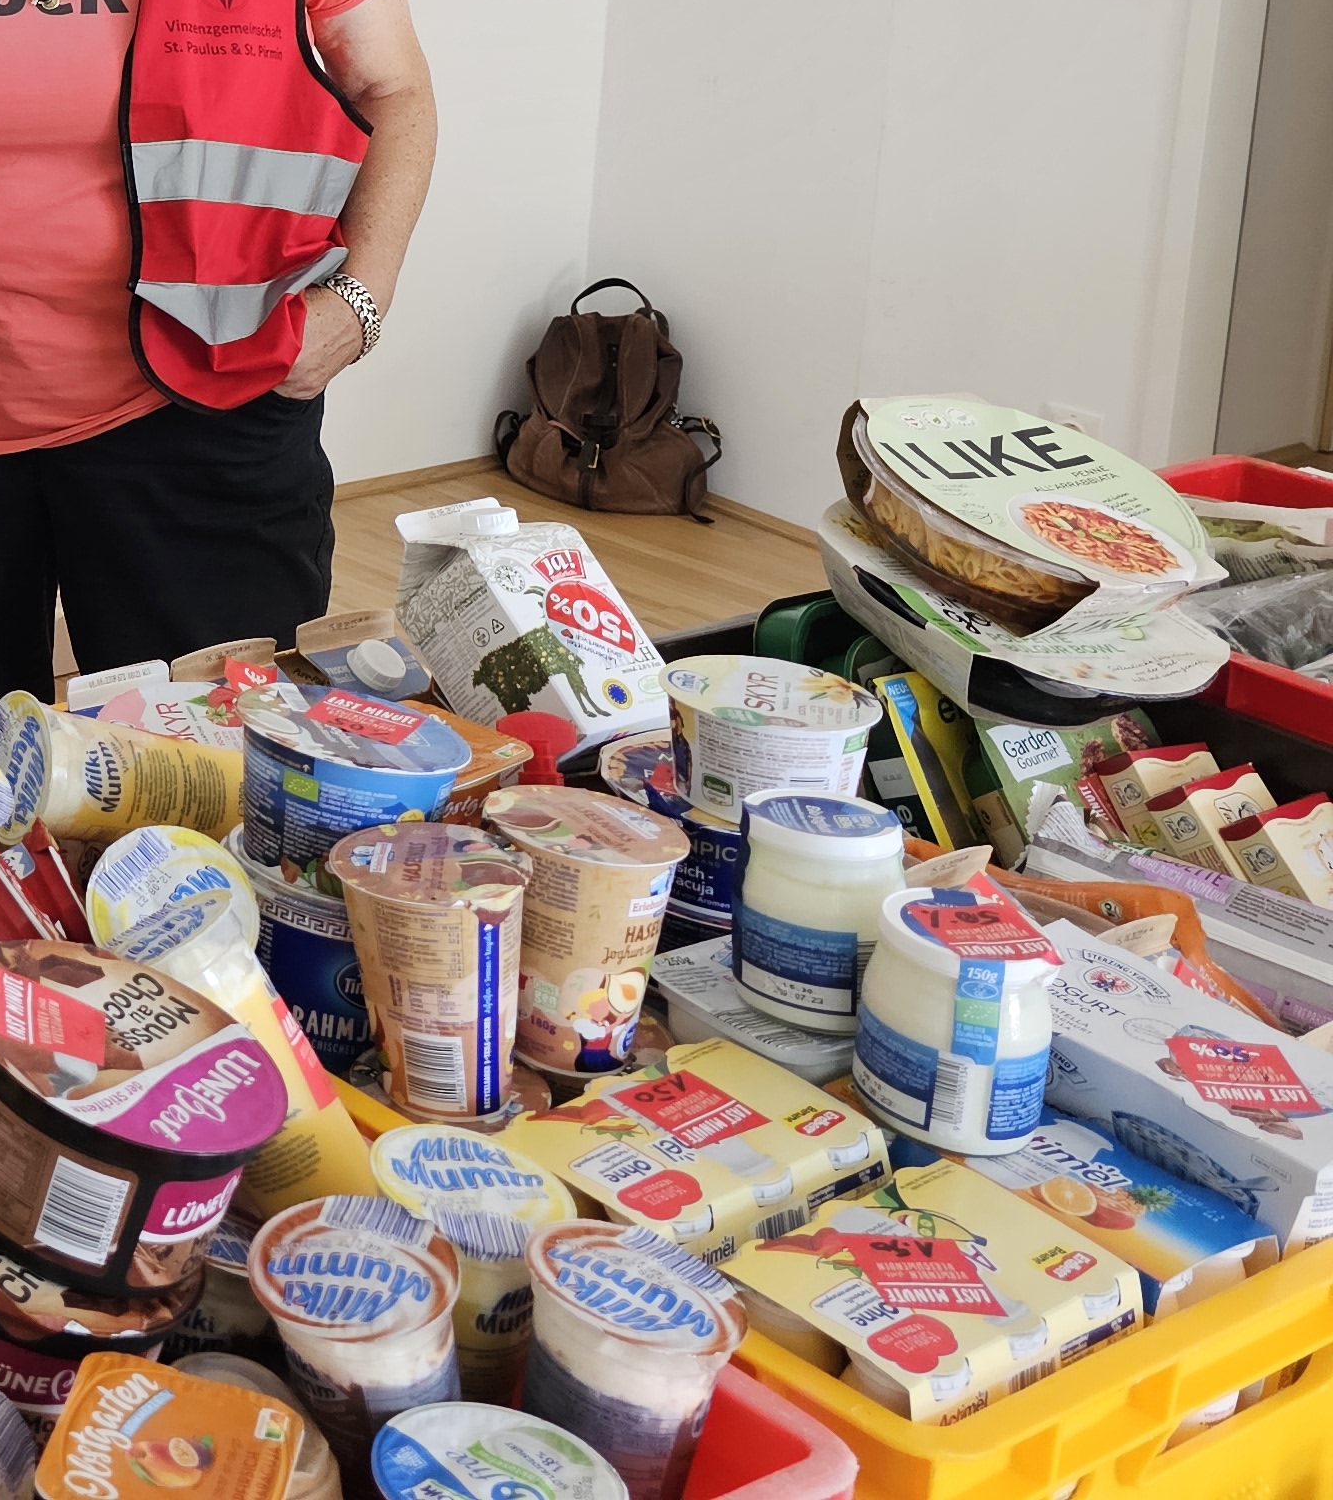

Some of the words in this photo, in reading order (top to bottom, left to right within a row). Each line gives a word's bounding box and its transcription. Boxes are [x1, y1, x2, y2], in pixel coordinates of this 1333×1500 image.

[165, 20, 282, 40] Vinzenzgemeinschaft
[164, 41, 183, 54] St.
[186, 41, 226, 56] Paulus
[231, 44, 242, 56] &
[245, 44, 256, 57] St.
[258, 45, 283, 61] Pirmin
[879, 442, 930, 479] I
[905, 425, 1094, 479] LIKE
[1034, 471, 1120, 493] ALL'ARRABBIATA
[1071, 465, 1109, 478] PENNE
[549, 590, 634, 650] -50%
[1071, 643, 1124, 654] BOWL
[744, 672, 779, 712] SKYR
[329, 696, 362, 711] LAST
[364, 706, 419, 726] MINUTE
[1002, 728, 1058, 760] Garden
[85, 738, 103, 800] Milki
[1017, 746, 1060, 770] Gourmet
[100, 741, 122, 814] Mumm
[673, 873, 714, 896] acuja
[677, 864, 705, 881] sich
[1130, 854, 1183, 883] KNOBLAUCH
[1185, 874, 1231, 905] KNOFLOOK
[624, 924, 660, 944] HASEL
[1017, 940, 1051, 953] LAST
[957, 944, 1014, 955] MINUTE
[1087, 952, 1129, 973] STERZING
[966, 965, 998, 984] 150g
[5, 970, 26, 1010] MINUTE
[1048, 988, 1092, 1014] ntero
[1051, 977, 1126, 1016] OGURT
[4, 1008, 23, 1042] LAST
[122, 995, 200, 1051] Mousse
[138, 1002, 155, 1024] au
[1051, 1013, 1093, 1035] OGHURT
[1206, 1085, 1266, 1101] MINUTE
[1271, 1085, 1309, 1102] LAST
[716, 1101, 753, 1128] LAST
[681, 1116, 722, 1148] MINUTE
[410, 1137, 509, 1166] Milki
[1031, 1134, 1132, 1193] timel
[391, 1157, 544, 1191] Mumm
[699, 1236, 736, 1266] timel
[268, 1251, 431, 1302] Mumm
[1047, 1252, 1093, 1278] Erdbeer
[283, 1281, 399, 1323] Milki
[546, 1243, 716, 1338] Mumm
[556, 1266, 682, 1333] Milki
[884, 1287, 952, 1306] MINUTE
[955, 1287, 991, 1306] LAST
[848, 1301, 901, 1328] ohne
[63, 1372, 161, 1500] Obstgarten
